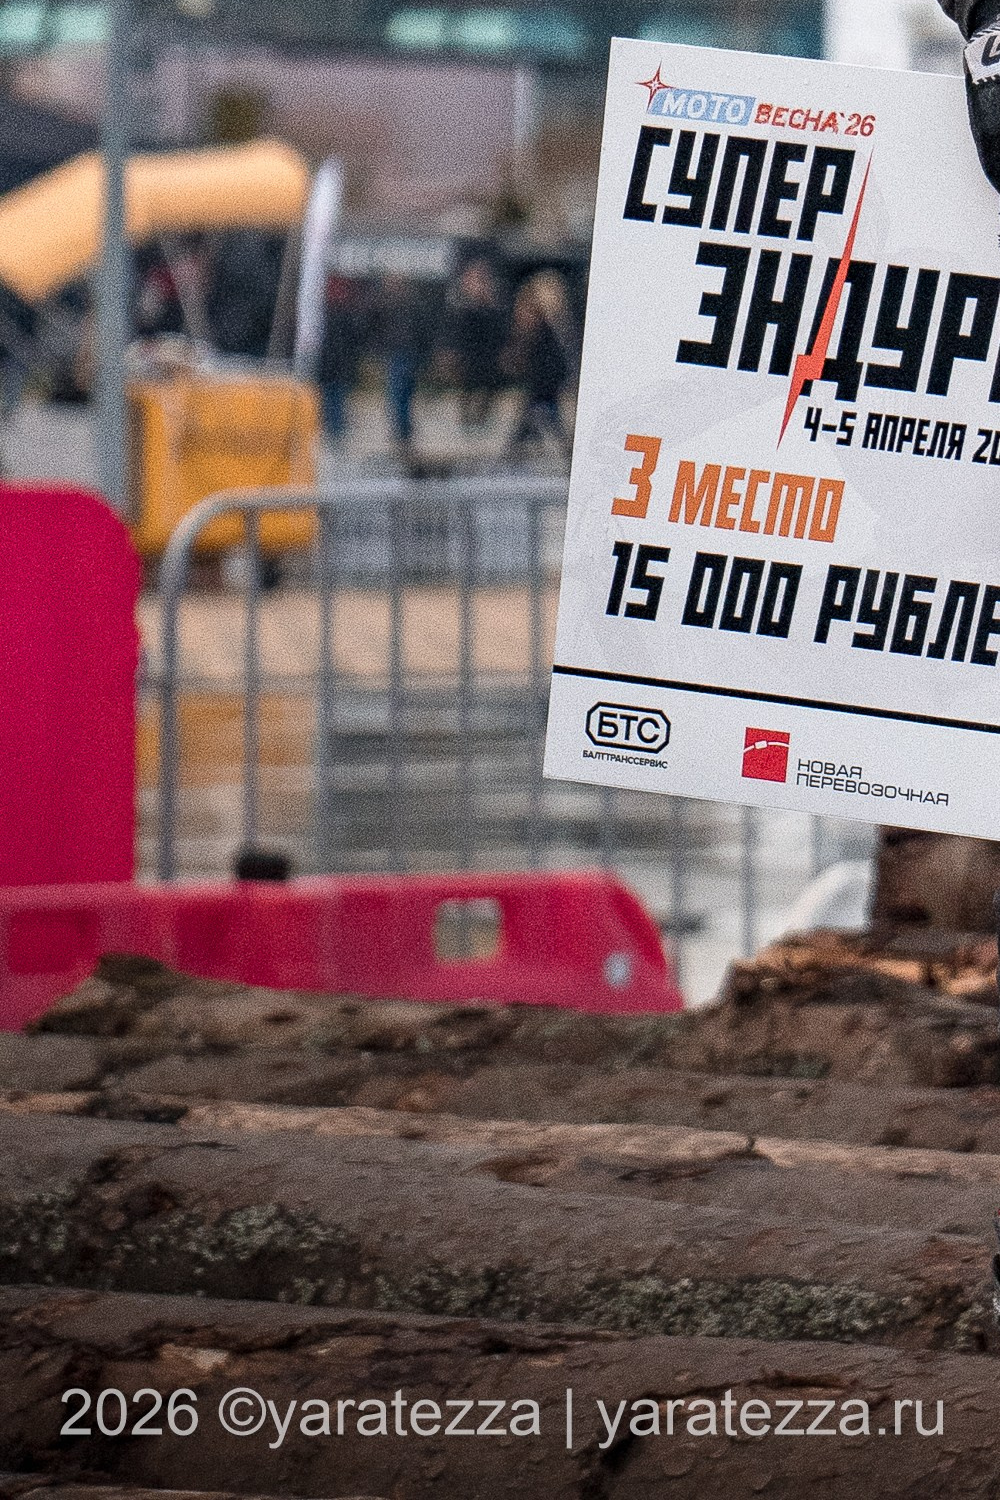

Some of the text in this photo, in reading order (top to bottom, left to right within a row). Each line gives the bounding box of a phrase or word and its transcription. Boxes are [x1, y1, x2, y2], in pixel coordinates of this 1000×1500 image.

[661, 92, 746, 125] МОТО
[622, 125, 855, 242] СУПЕР
[862, 412, 966, 460] АПРЕЛЯ
[611, 434, 846, 543] 3 МЕСТО
[605, 540, 671, 621] 15
[681, 551, 803, 638] 000
[598, 713, 660, 744] БТС
[582, 749, 668, 770] БАЛТТРАНССЕРВИС
[797, 758, 863, 780] НОВАЯ
[796, 774, 950, 807] ПЕРЕВОЗОЧНАЯ
